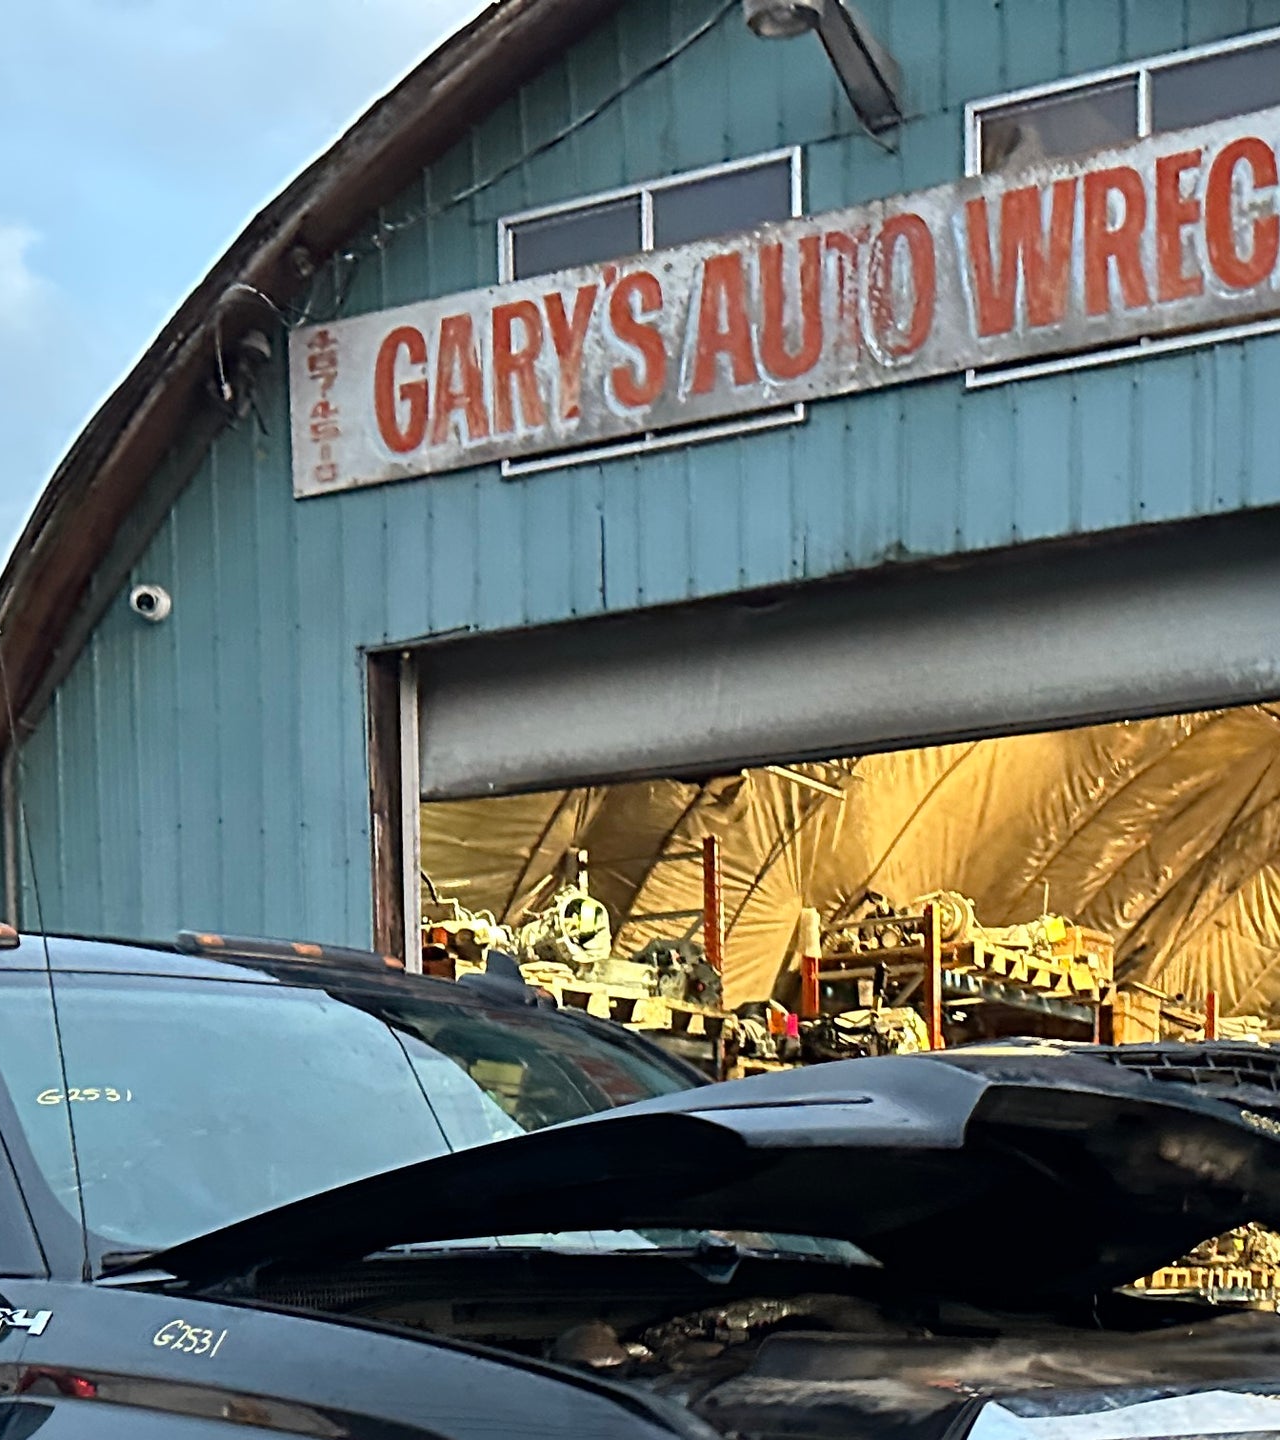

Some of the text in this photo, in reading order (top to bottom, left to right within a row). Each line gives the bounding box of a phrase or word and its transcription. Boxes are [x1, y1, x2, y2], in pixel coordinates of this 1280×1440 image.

[373, 263, 669, 454] GARY'S
[692, 212, 936, 395] AUTO
[36, 1087, 132, 1105] G2531
[153, 1319, 228, 1358] G2531
